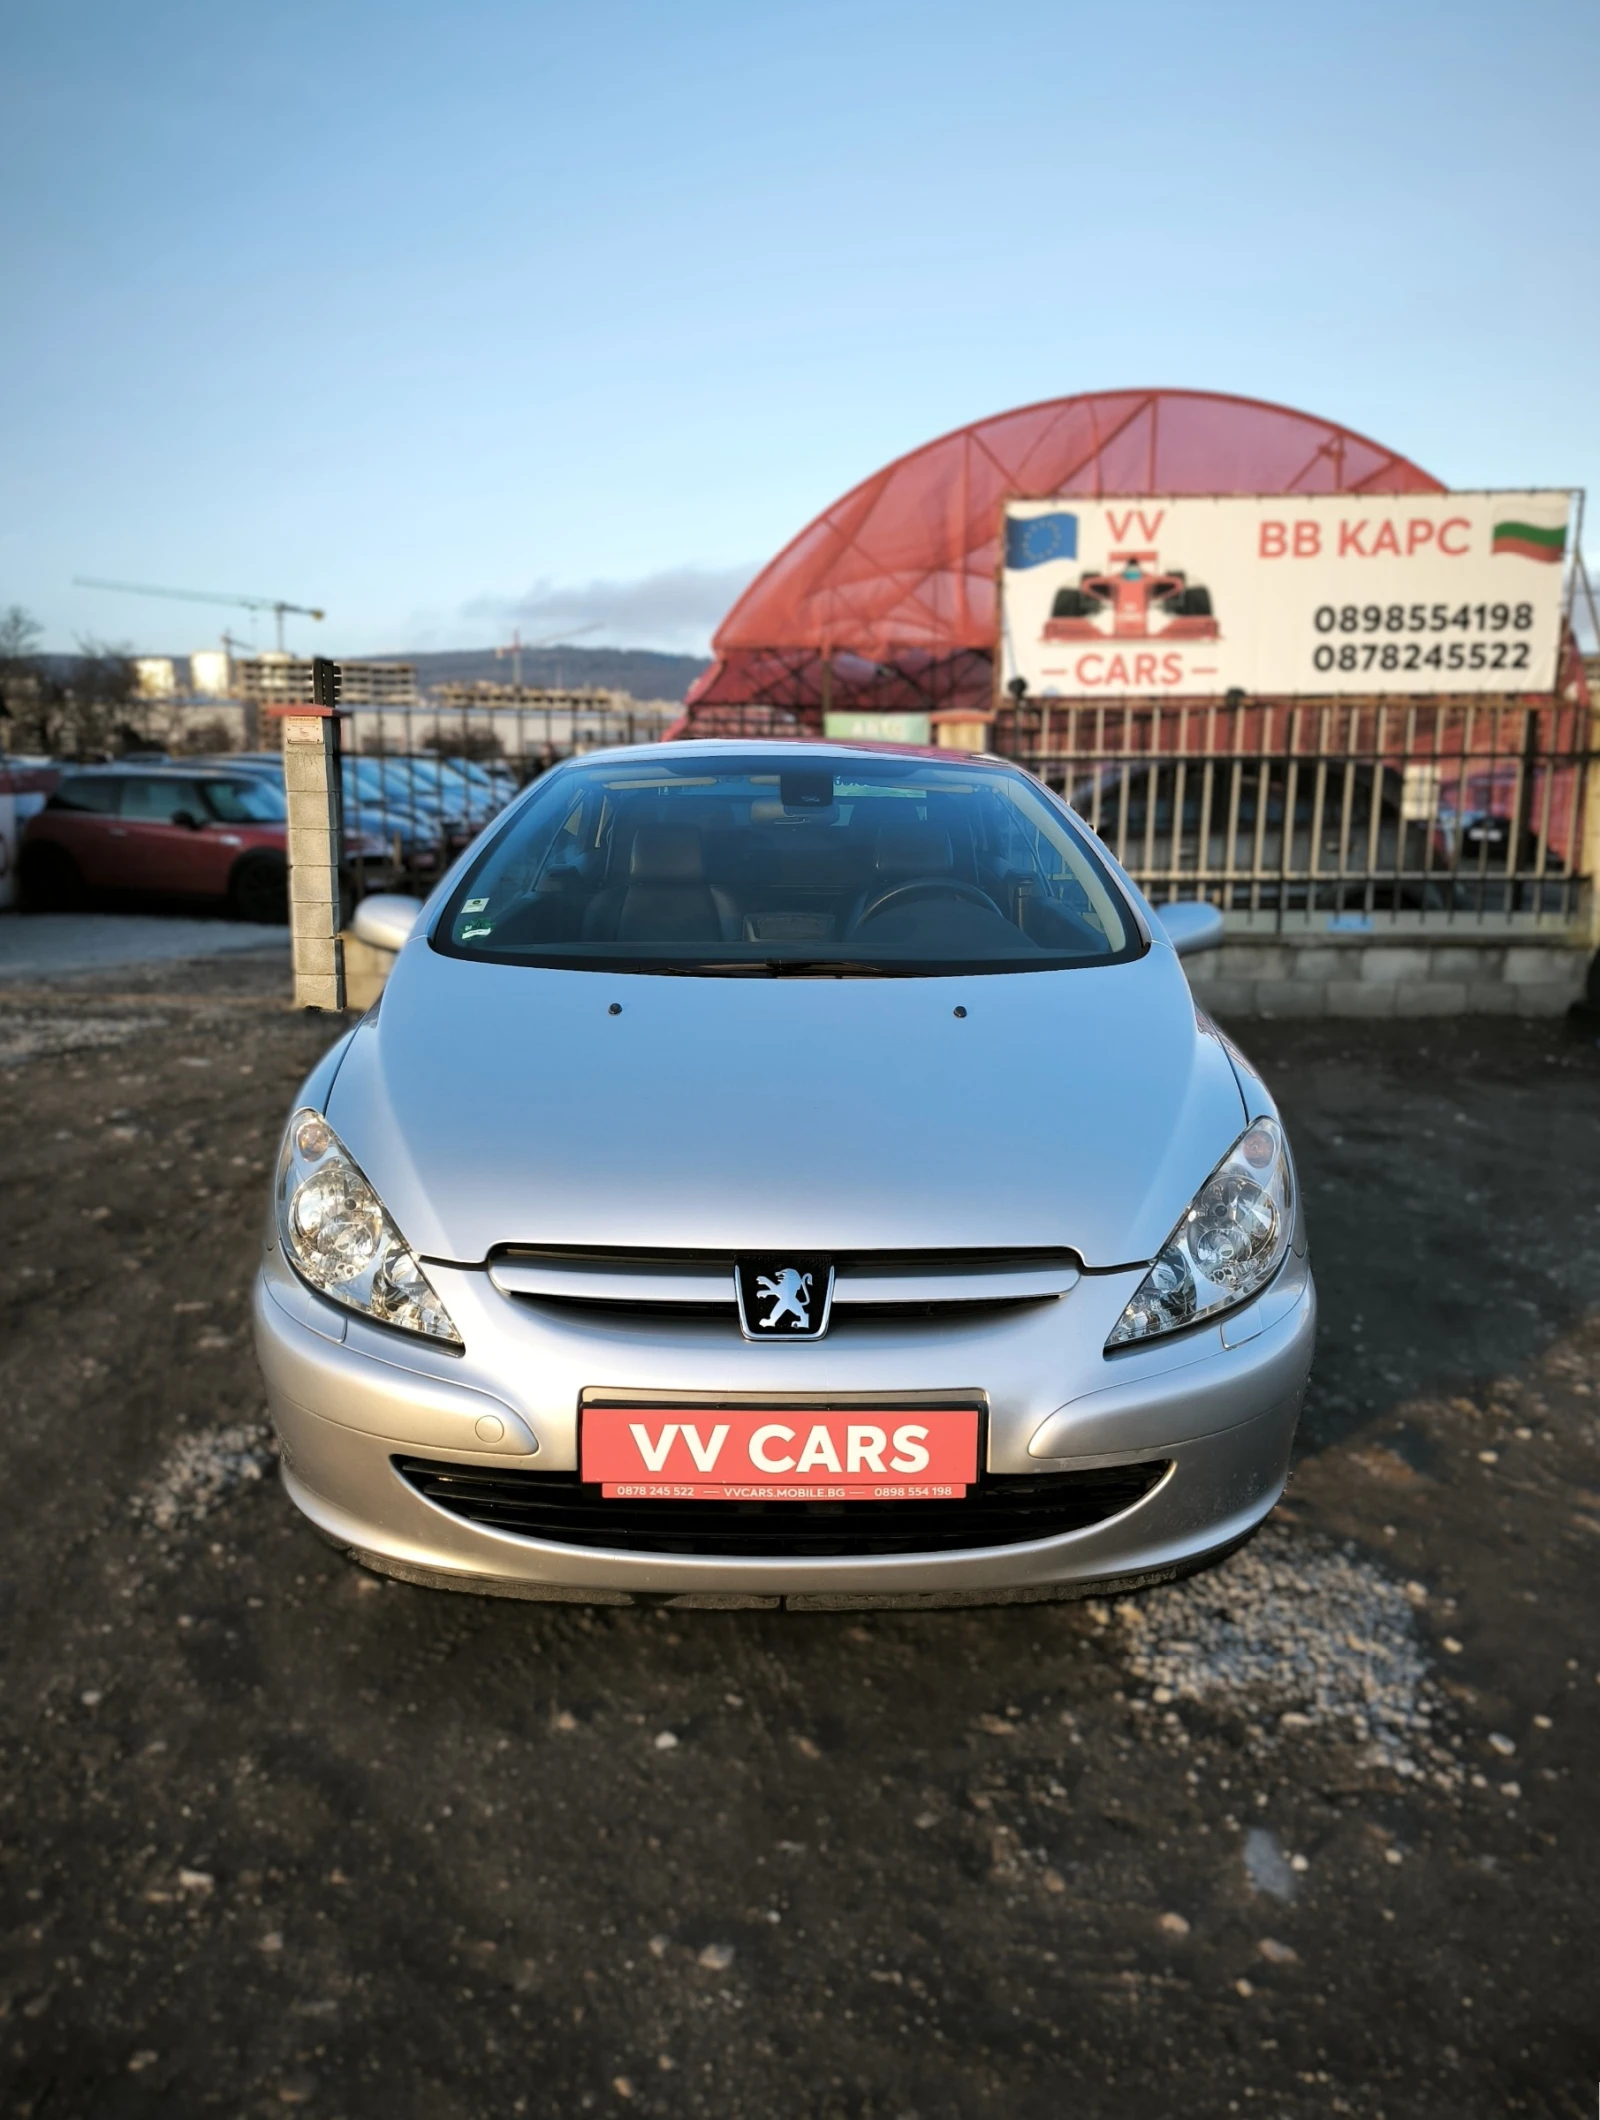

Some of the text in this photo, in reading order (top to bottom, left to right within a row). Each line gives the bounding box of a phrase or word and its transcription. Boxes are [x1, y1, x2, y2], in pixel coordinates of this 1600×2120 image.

[1106, 511, 1164, 542] VV
[1257, 517, 1471, 560] ВВ КАРС
[1314, 603, 1533, 633] 0898554198
[1075, 653, 1182, 687] CARS
[1313, 642, 1530, 672] 0878245522
[628, 1423, 930, 1474] VV CARS
[616, 1486, 953, 1498] 0878 245 522 VVCARS.MOBILE.BG 0898 554 198
